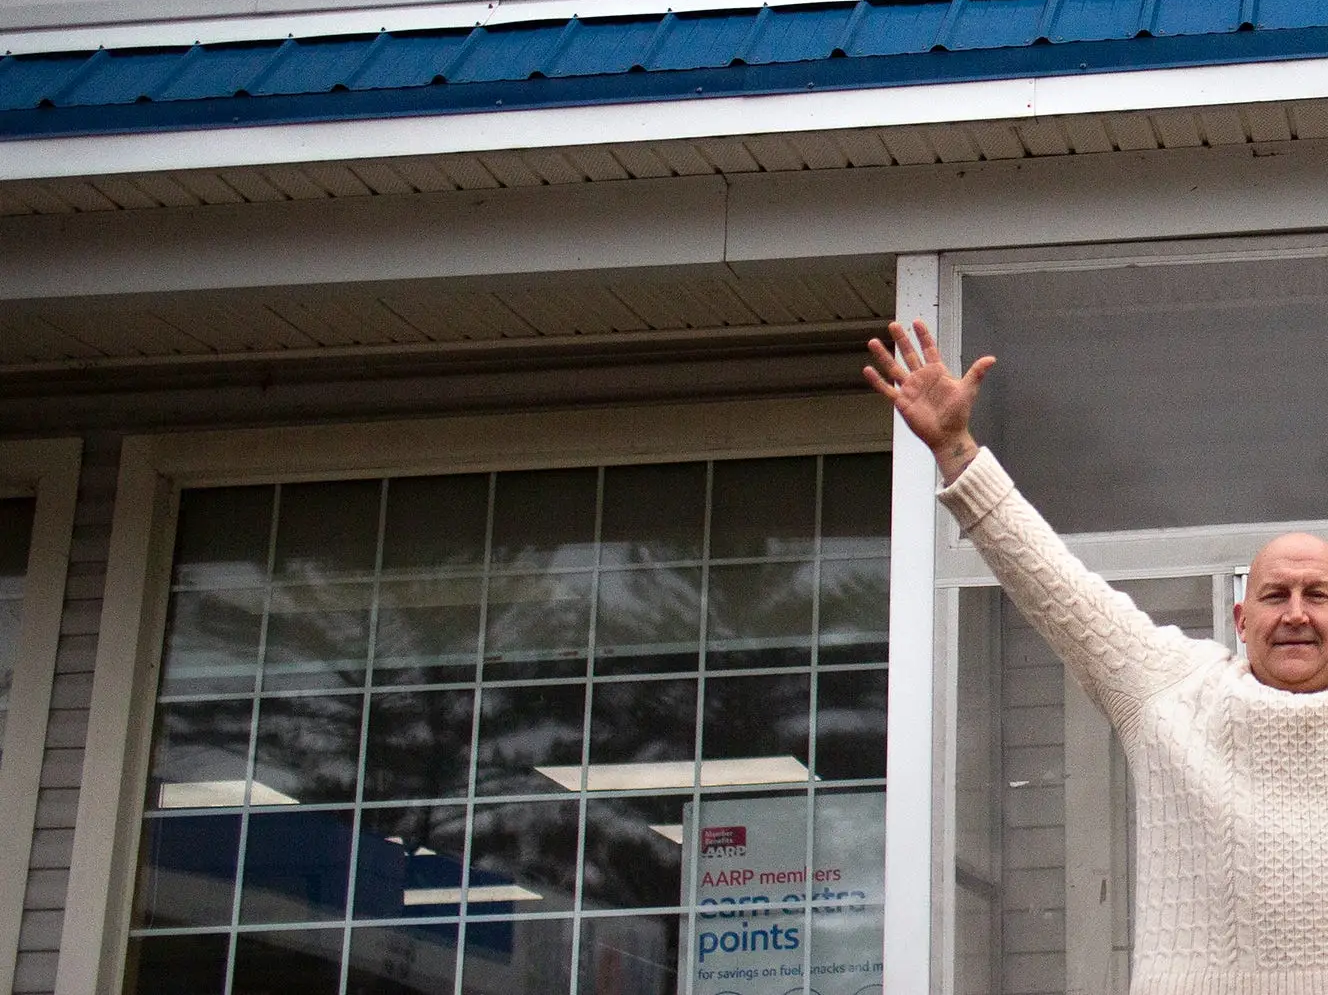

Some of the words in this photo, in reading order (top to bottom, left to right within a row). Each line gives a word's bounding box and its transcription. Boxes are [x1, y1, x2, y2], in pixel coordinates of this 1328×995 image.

[701, 869, 754, 887] AARP
[700, 895, 770, 919] earn
[699, 922, 799, 963] points
[698, 970, 714, 980] for
[717, 969, 759, 981] savings
[762, 968, 777, 977] on
[780, 964, 804, 976] fuel,
[848, 960, 869, 972] and
